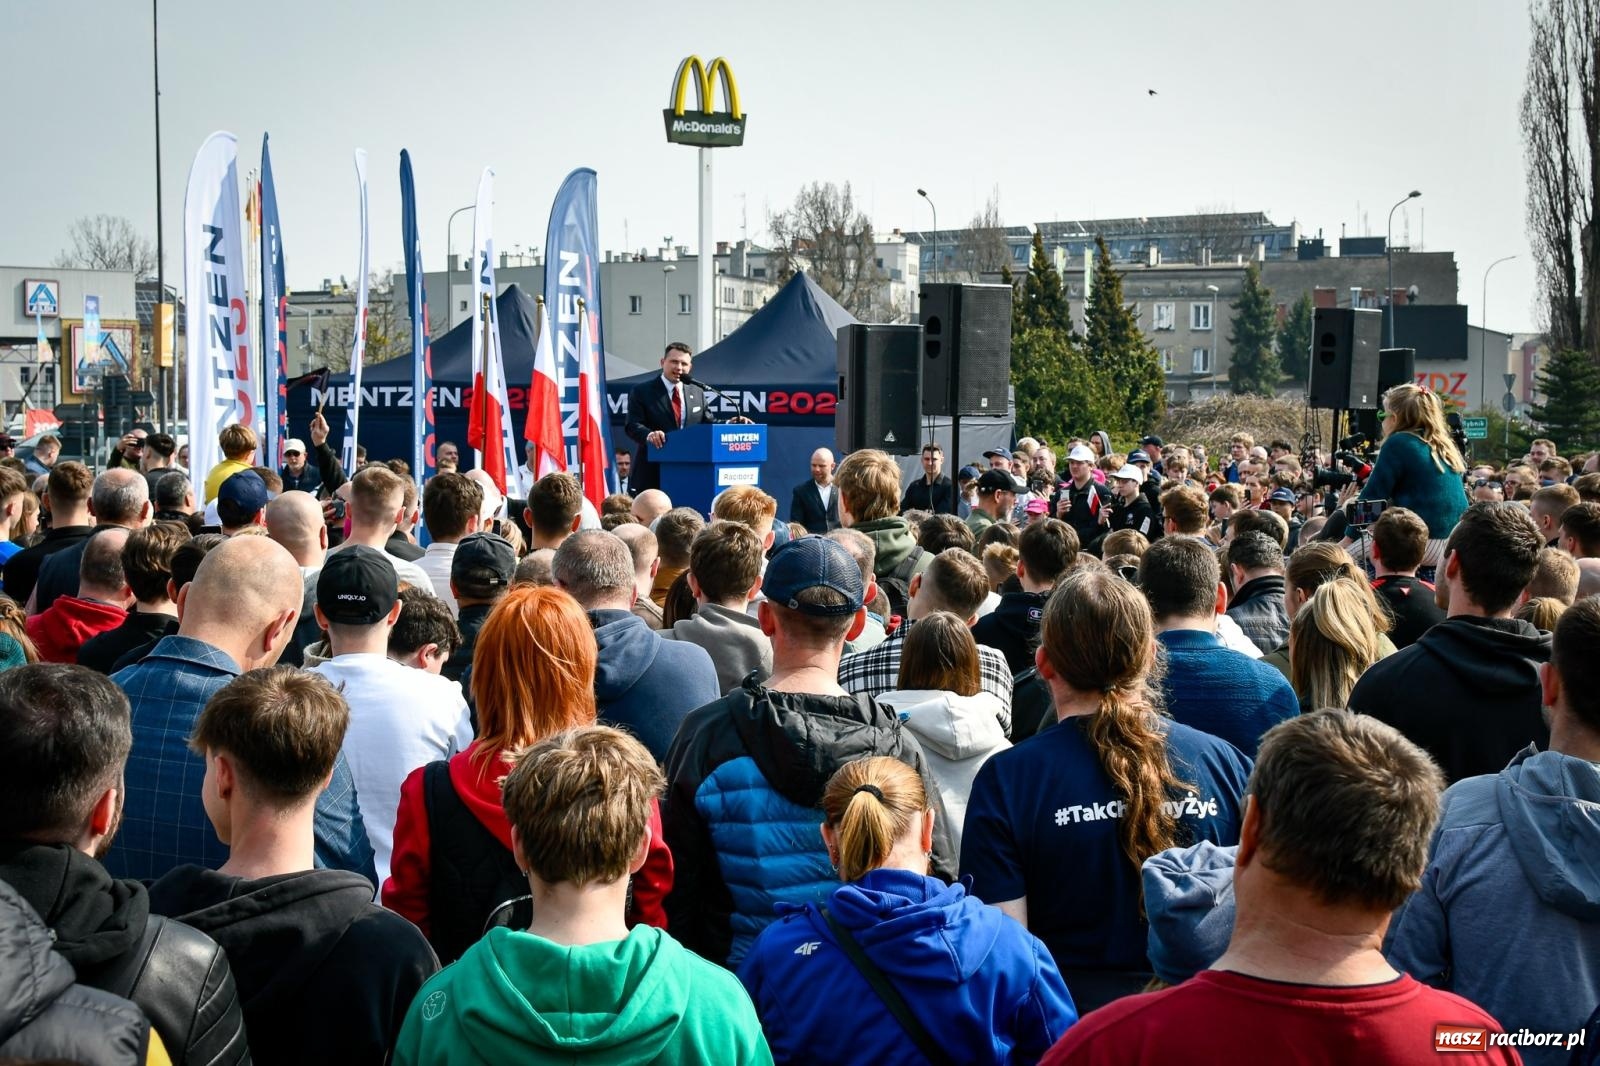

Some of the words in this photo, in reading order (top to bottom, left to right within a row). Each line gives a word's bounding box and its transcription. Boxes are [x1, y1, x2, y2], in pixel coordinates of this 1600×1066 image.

[672, 120, 741, 135] McDonald's
[203, 224, 237, 463] NTZEN
[721, 433, 759, 442] MENTZEN
[728, 442, 752, 451] 2025
[1055, 792, 1218, 826] #TakChmyŻyć
[794, 942, 822, 955] 4F
